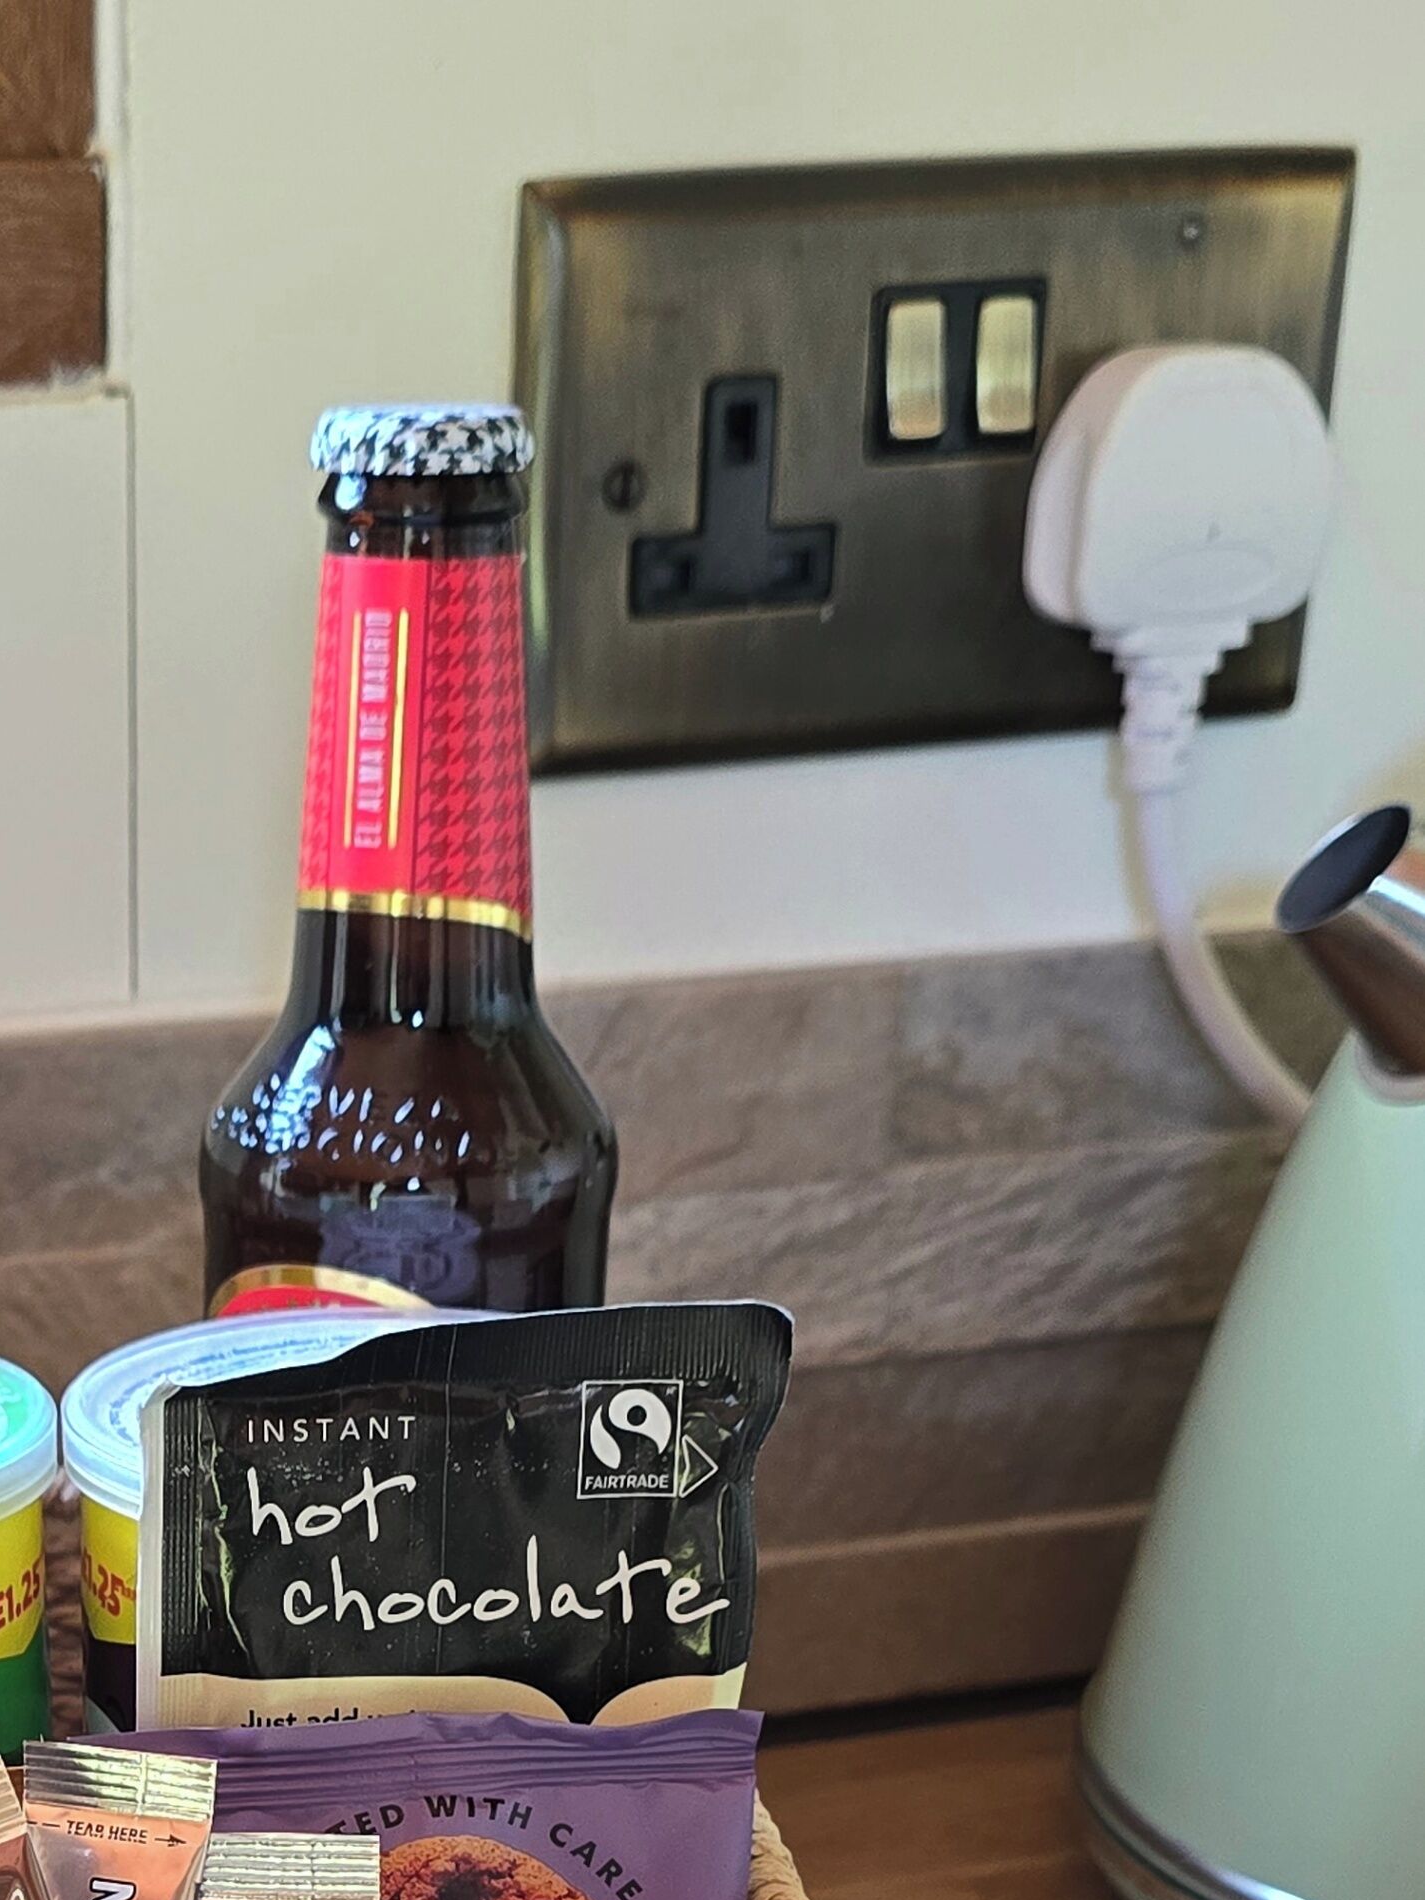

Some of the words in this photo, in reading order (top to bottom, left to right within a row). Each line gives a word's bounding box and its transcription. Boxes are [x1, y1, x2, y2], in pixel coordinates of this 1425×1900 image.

[362, 610, 393, 702] MADRID
[359, 710, 388, 741] DE
[357, 748, 385, 812] ALMA
[354, 822, 383, 848] EL
[247, 1415, 417, 1444] INSTANT
[583, 1471, 670, 1492] FAIRTRADE
[246, 1466, 417, 1546] hot
[282, 1535, 731, 1631] chocolate
[424, 1794, 534, 1830] WITH
[67, 1819, 105, 1839] TEAR
[107, 1825, 149, 1845] HERE
